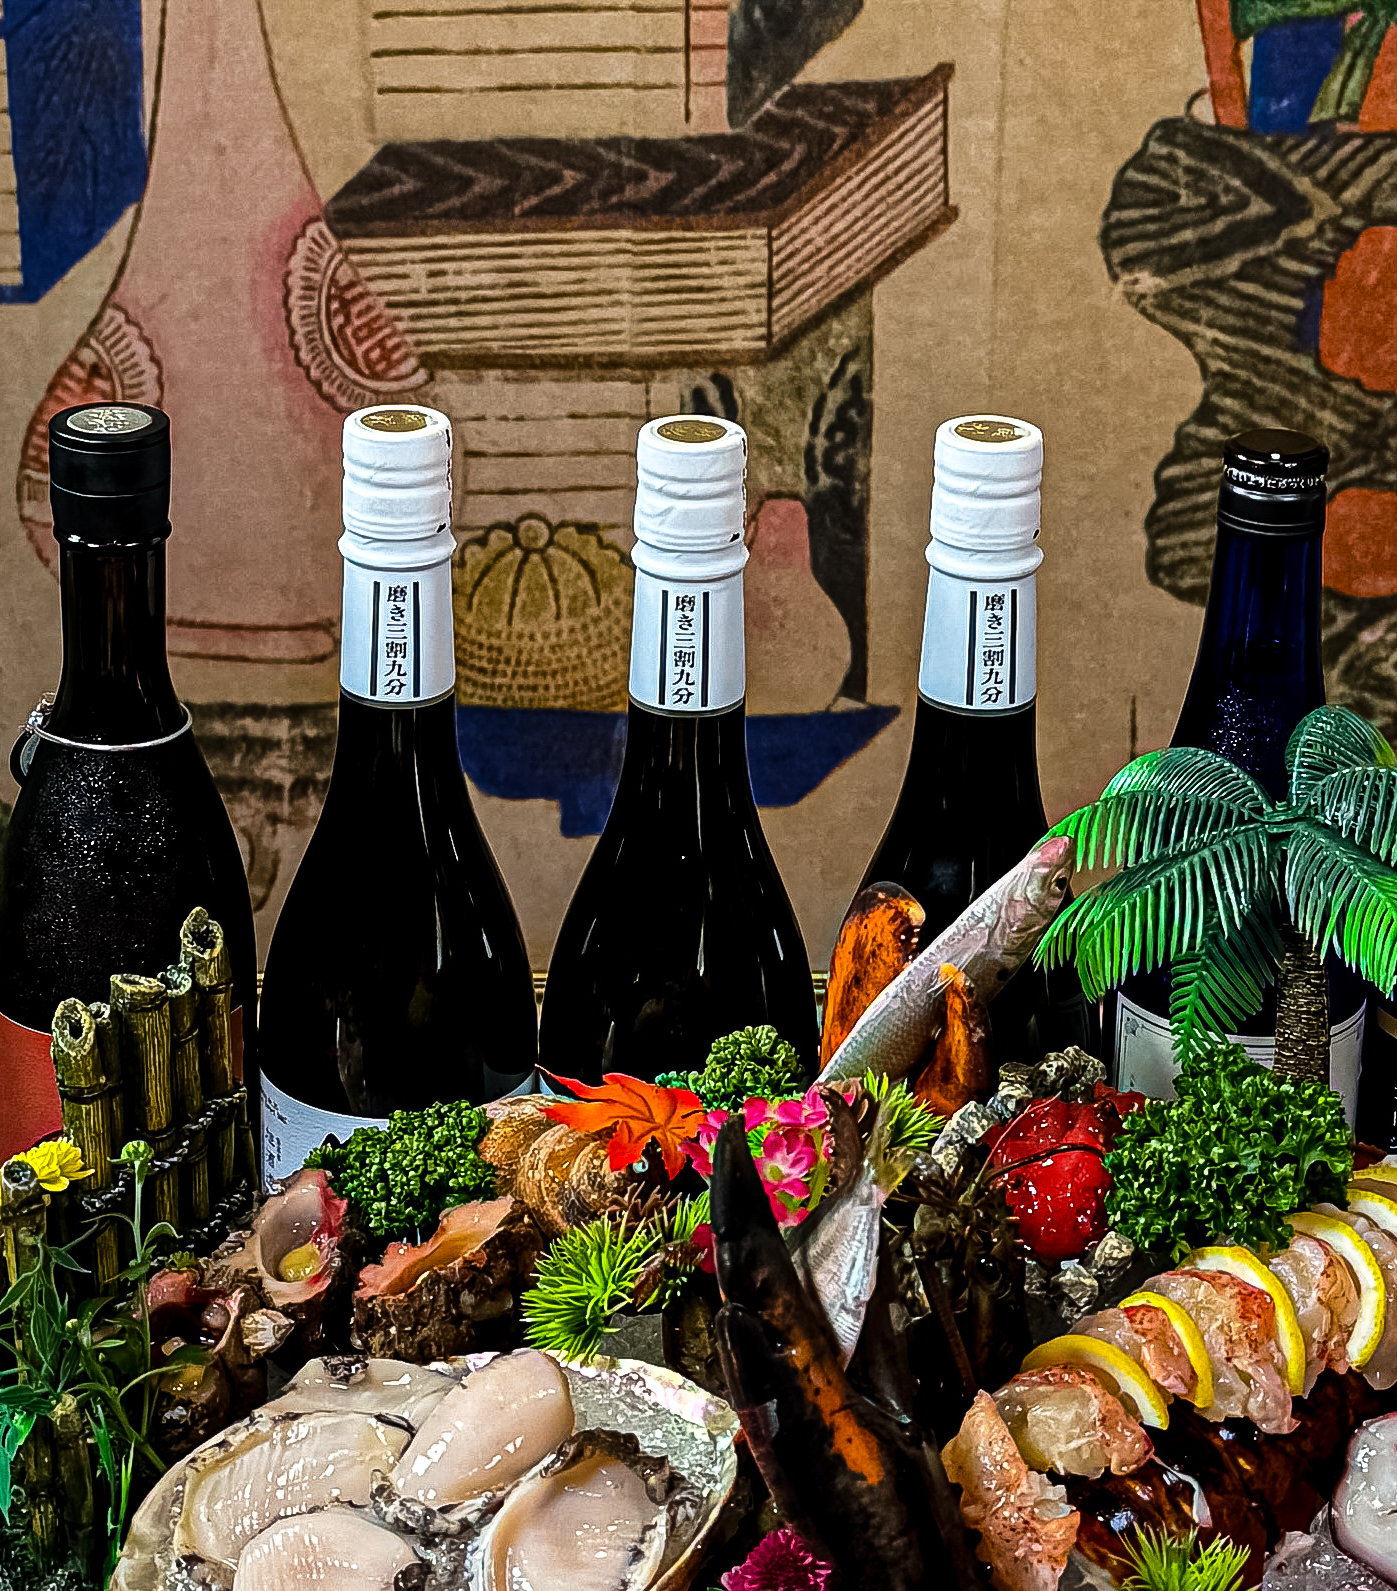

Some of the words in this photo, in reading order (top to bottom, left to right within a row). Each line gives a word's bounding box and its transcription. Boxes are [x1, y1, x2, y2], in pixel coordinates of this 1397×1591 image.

[385, 585, 409, 698] 磨き三割九分
[673, 593, 696, 706] 磨き三割九分
[980, 593, 1005, 706] 磨き三割九分
